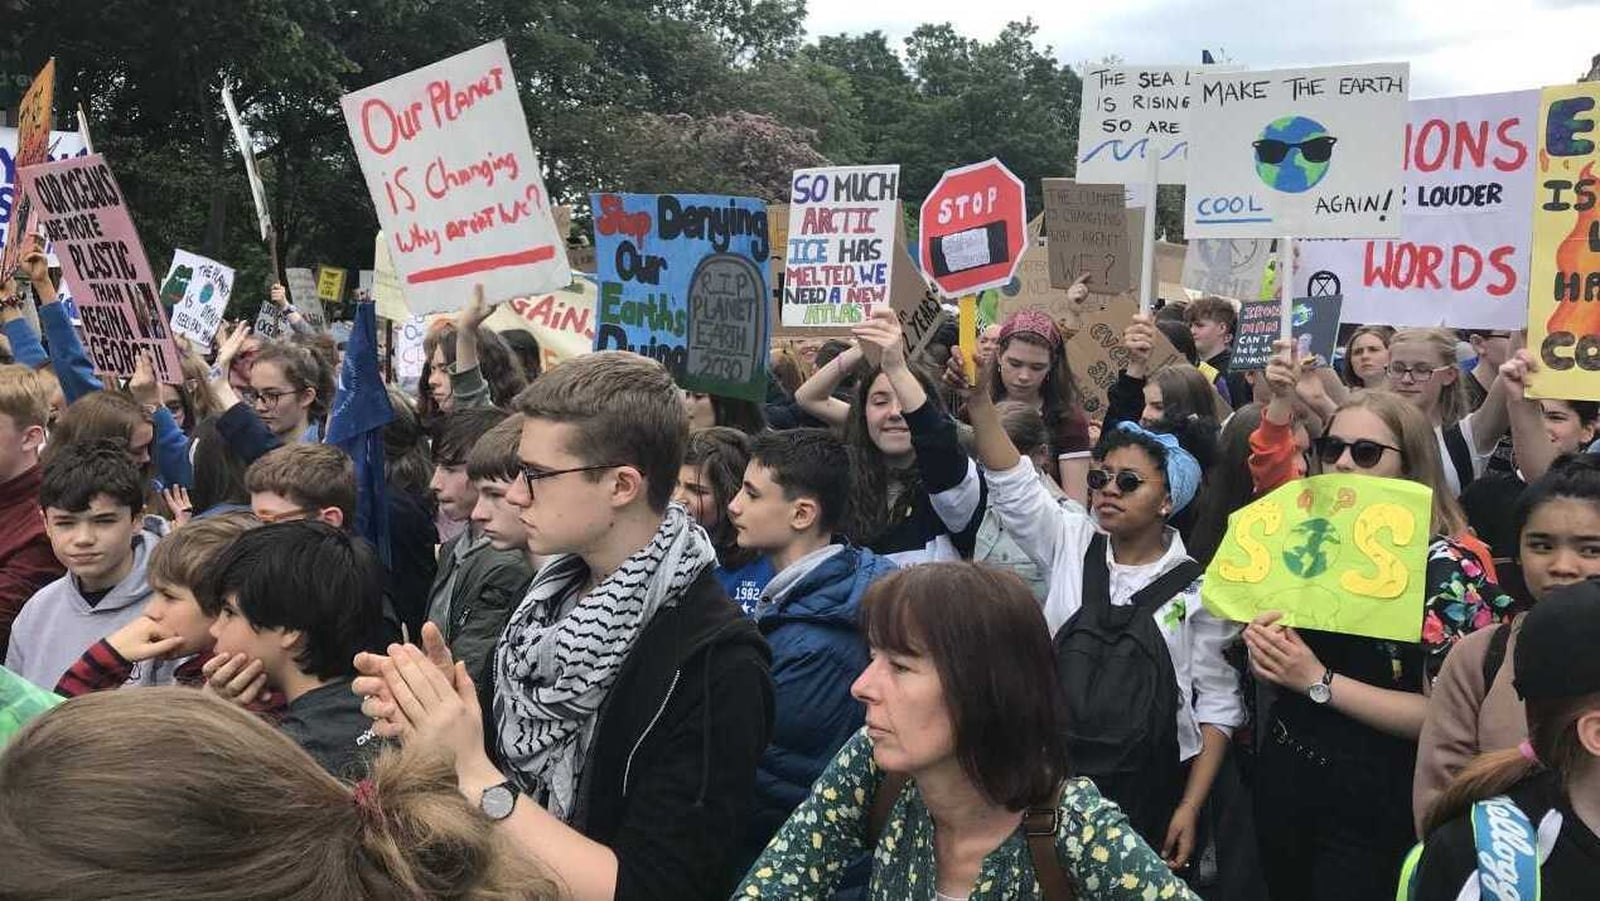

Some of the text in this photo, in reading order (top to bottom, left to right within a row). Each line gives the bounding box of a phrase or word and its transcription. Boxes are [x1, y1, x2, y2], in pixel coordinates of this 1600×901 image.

[1090, 69, 1126, 90] THE
[1138, 72, 1174, 88] SEA
[1203, 76, 1403, 106] MAKE THE EARTH
[1097, 95, 1190, 112] IS RISING
[361, 98, 422, 155] Our
[1102, 119, 1180, 134] SO ARE
[35, 164, 120, 214] OUR OCEANS
[793, 173, 896, 204] SO MUCH
[1418, 182, 1503, 207] LOUDER
[1542, 179, 1597, 212] IS
[801, 207, 879, 234] ARCTIC
[937, 187, 998, 224] STOP
[1197, 194, 1263, 216] COOL
[1316, 189, 1392, 222] AGAIN!
[46, 213, 103, 242] ARE MORE
[597, 194, 769, 262] Stop Denying
[68, 240, 137, 281] PLASTIC
[615, 240, 668, 285] Our
[788, 238, 883, 264] ICE HAS
[859, 263, 887, 285] WE
[1363, 241, 1517, 297] WORDS
[90, 283, 121, 304] THAN
[784, 286, 886, 304] NEED A NEW
[80, 305, 134, 339] REGINA
[693, 296, 753, 323] PLANET
[696, 321, 747, 351] EARTH
[734, 587, 760, 600] 1982
